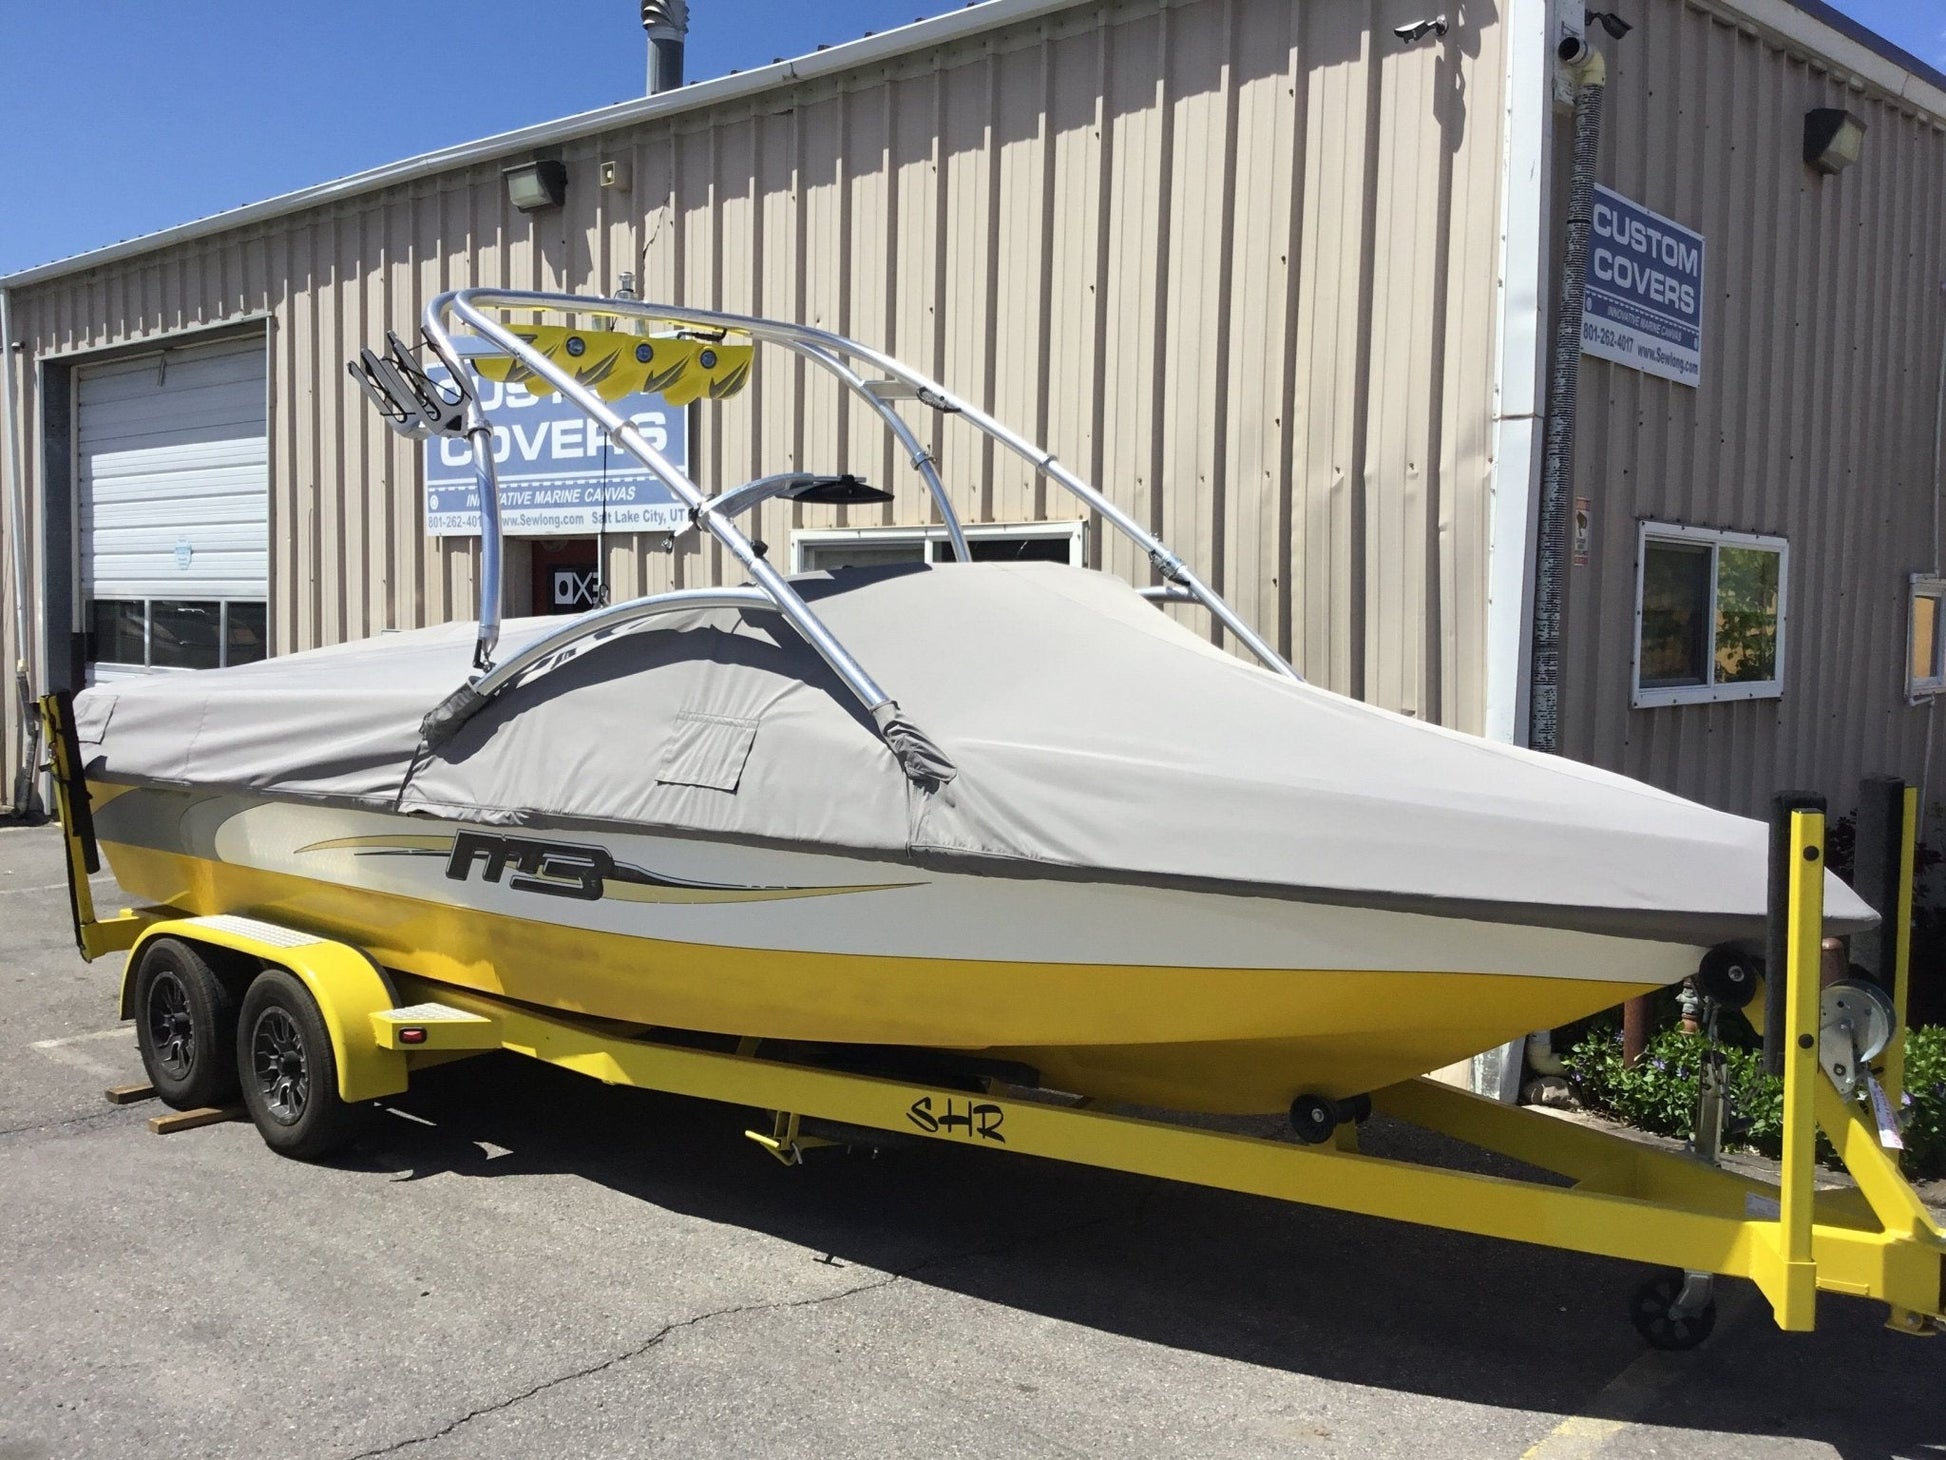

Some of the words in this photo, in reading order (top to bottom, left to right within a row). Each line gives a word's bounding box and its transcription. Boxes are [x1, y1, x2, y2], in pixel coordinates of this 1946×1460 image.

[1593, 203, 1698, 277] CUSTOM
[1594, 248, 1695, 315] COVERS
[1607, 306, 1640, 327] INNOVATIVE
[1640, 318, 1661, 335] MARINE
[1583, 322, 1634, 353] 801-262-4017
[1637, 344, 1699, 375] www.Sewlong.com
[428, 515, 482, 529] 801-262-401
[502, 513, 584, 529] ww.Sewlong.com
[615, 510, 639, 524] Lake
[643, 509, 667, 526] City,
[670, 508, 685, 522] UT
[466, 491, 532, 507] INATIVE
[534, 488, 581, 505] MARINE
[584, 486, 636, 503] CANVAS
[906, 1096, 1006, 1143] SHR
